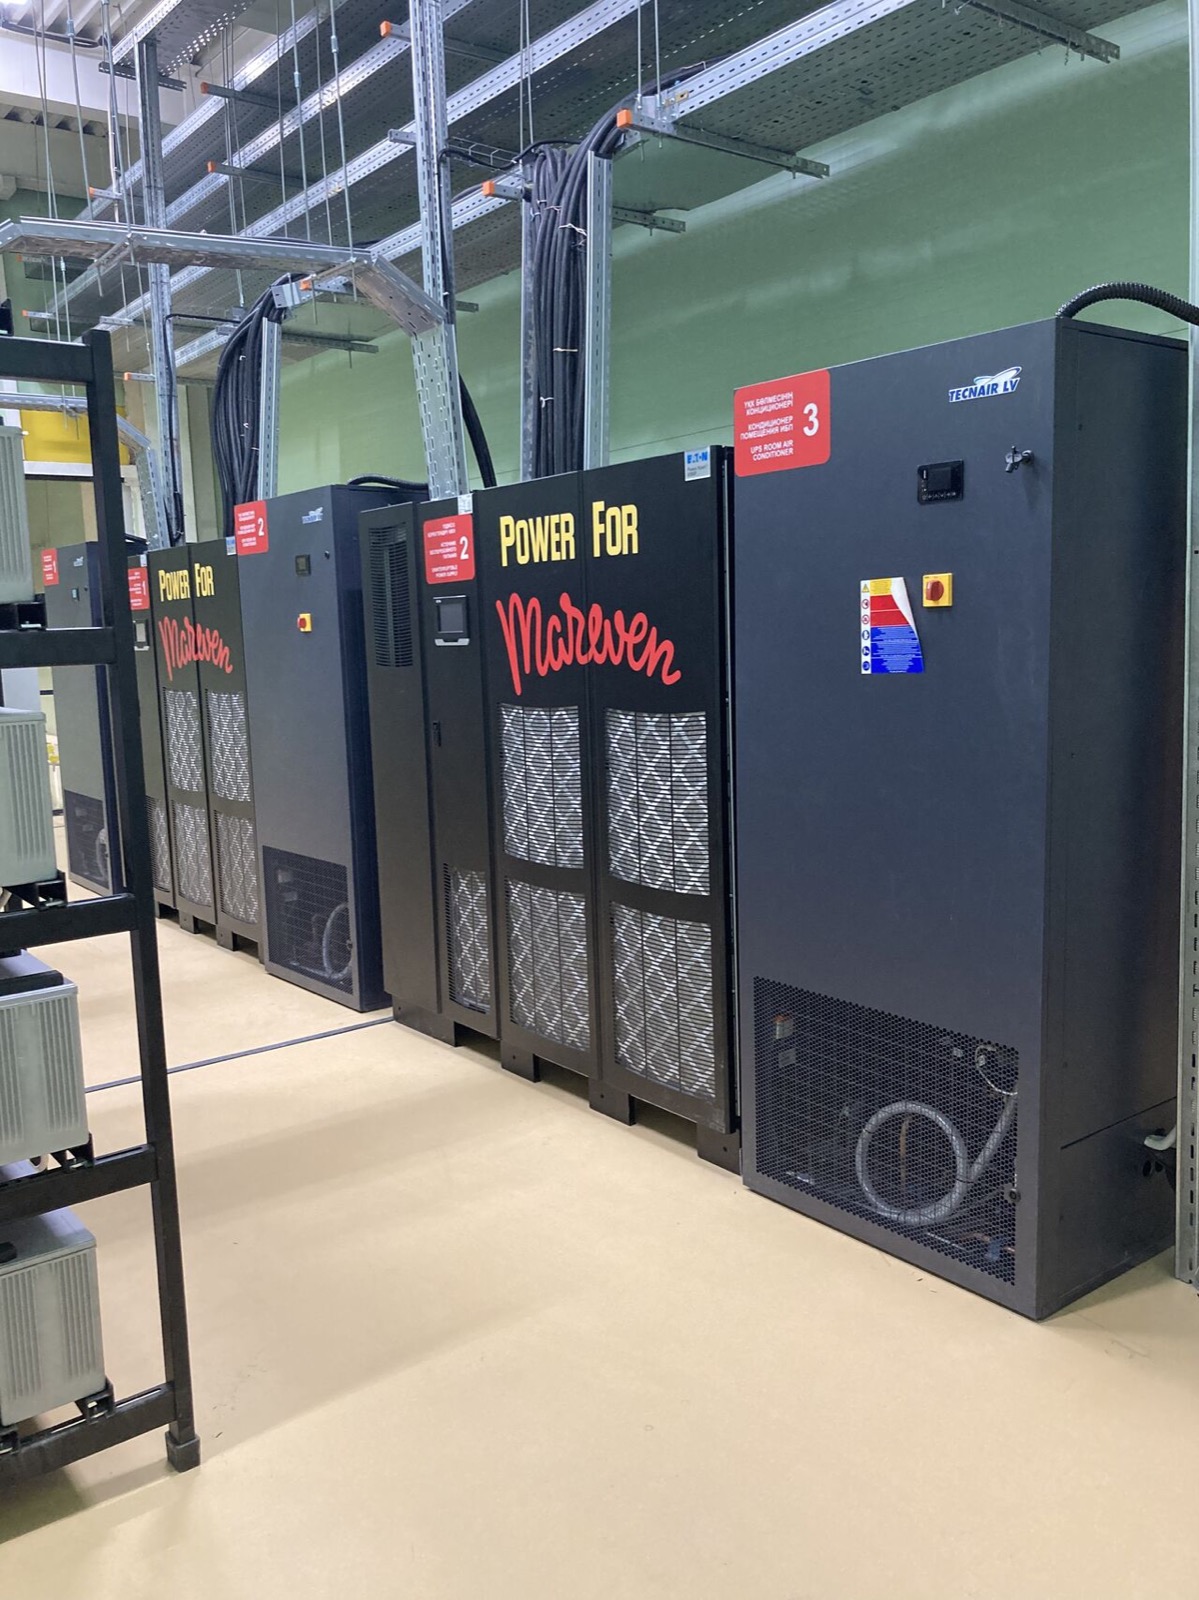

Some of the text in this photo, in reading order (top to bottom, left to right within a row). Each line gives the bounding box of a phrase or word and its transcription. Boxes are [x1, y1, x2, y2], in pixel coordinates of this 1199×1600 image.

[949, 379, 1018, 402] TECNAIR LV
[803, 402, 819, 436] 3
[740, 427, 779, 440] ПОМЕЩЕНИЯ
[750, 440, 793, 454] UPS ROOM AIR
[753, 448, 793, 461] CONDITIONER
[257, 517, 265, 536] 2
[500, 500, 639, 567] POWER FOR
[459, 535, 469, 560] 2
[158, 562, 215, 602] POWER FOR
[158, 616, 233, 682] Mareven
[495, 592, 682, 696] Mareven
